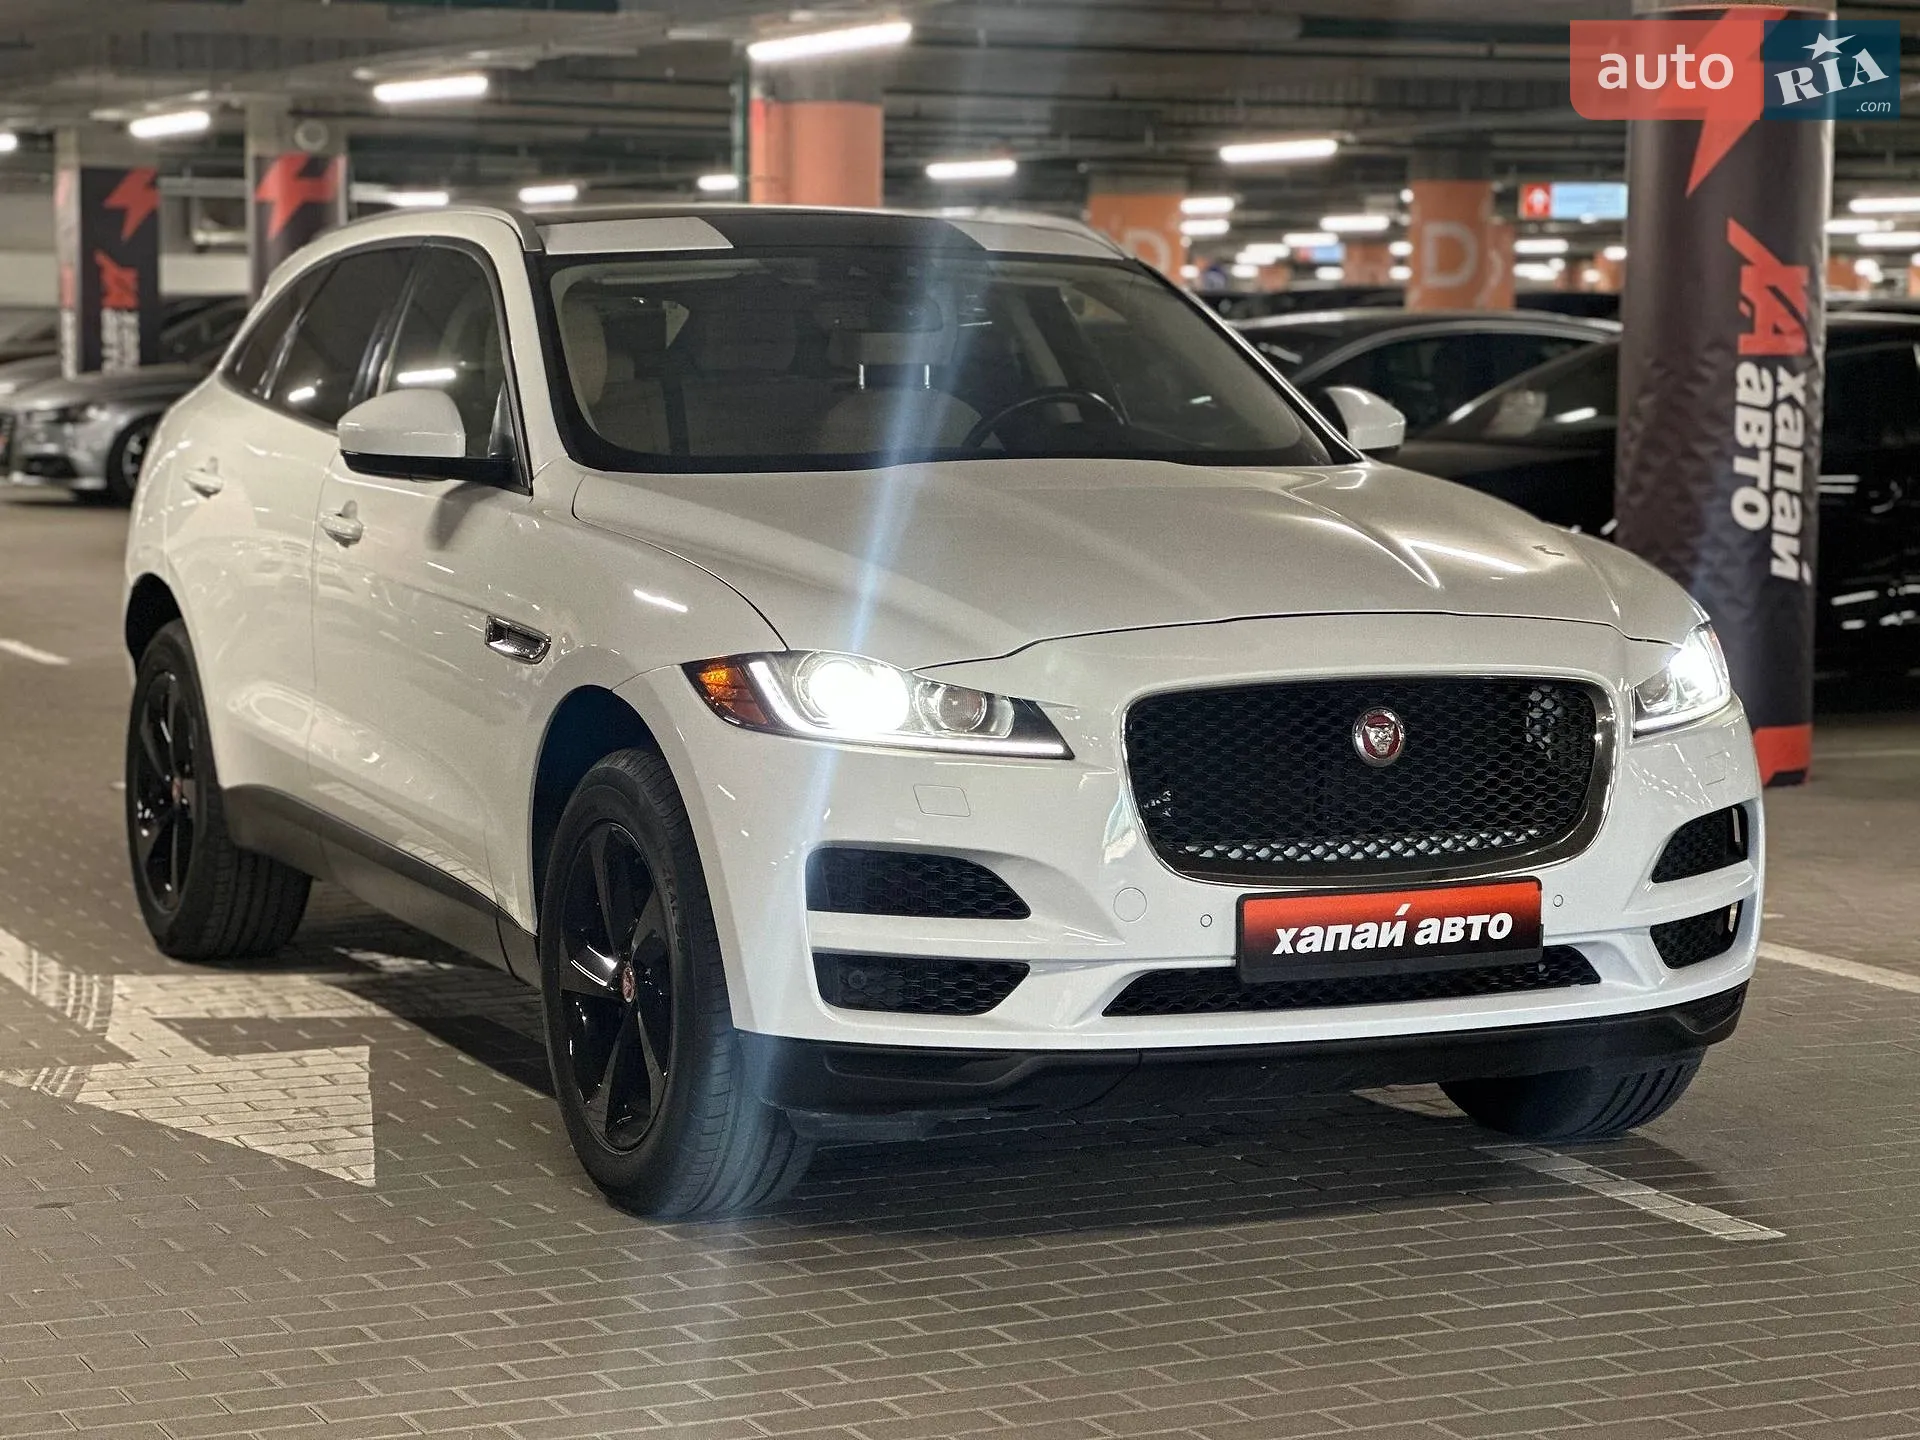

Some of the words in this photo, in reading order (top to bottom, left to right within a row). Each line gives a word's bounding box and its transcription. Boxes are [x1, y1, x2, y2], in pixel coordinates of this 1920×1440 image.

[1731, 361, 1773, 531] авто
[1771, 365, 1812, 585] хапай
[1272, 903, 1411, 955] хапай
[1414, 912, 1513, 946] авто
